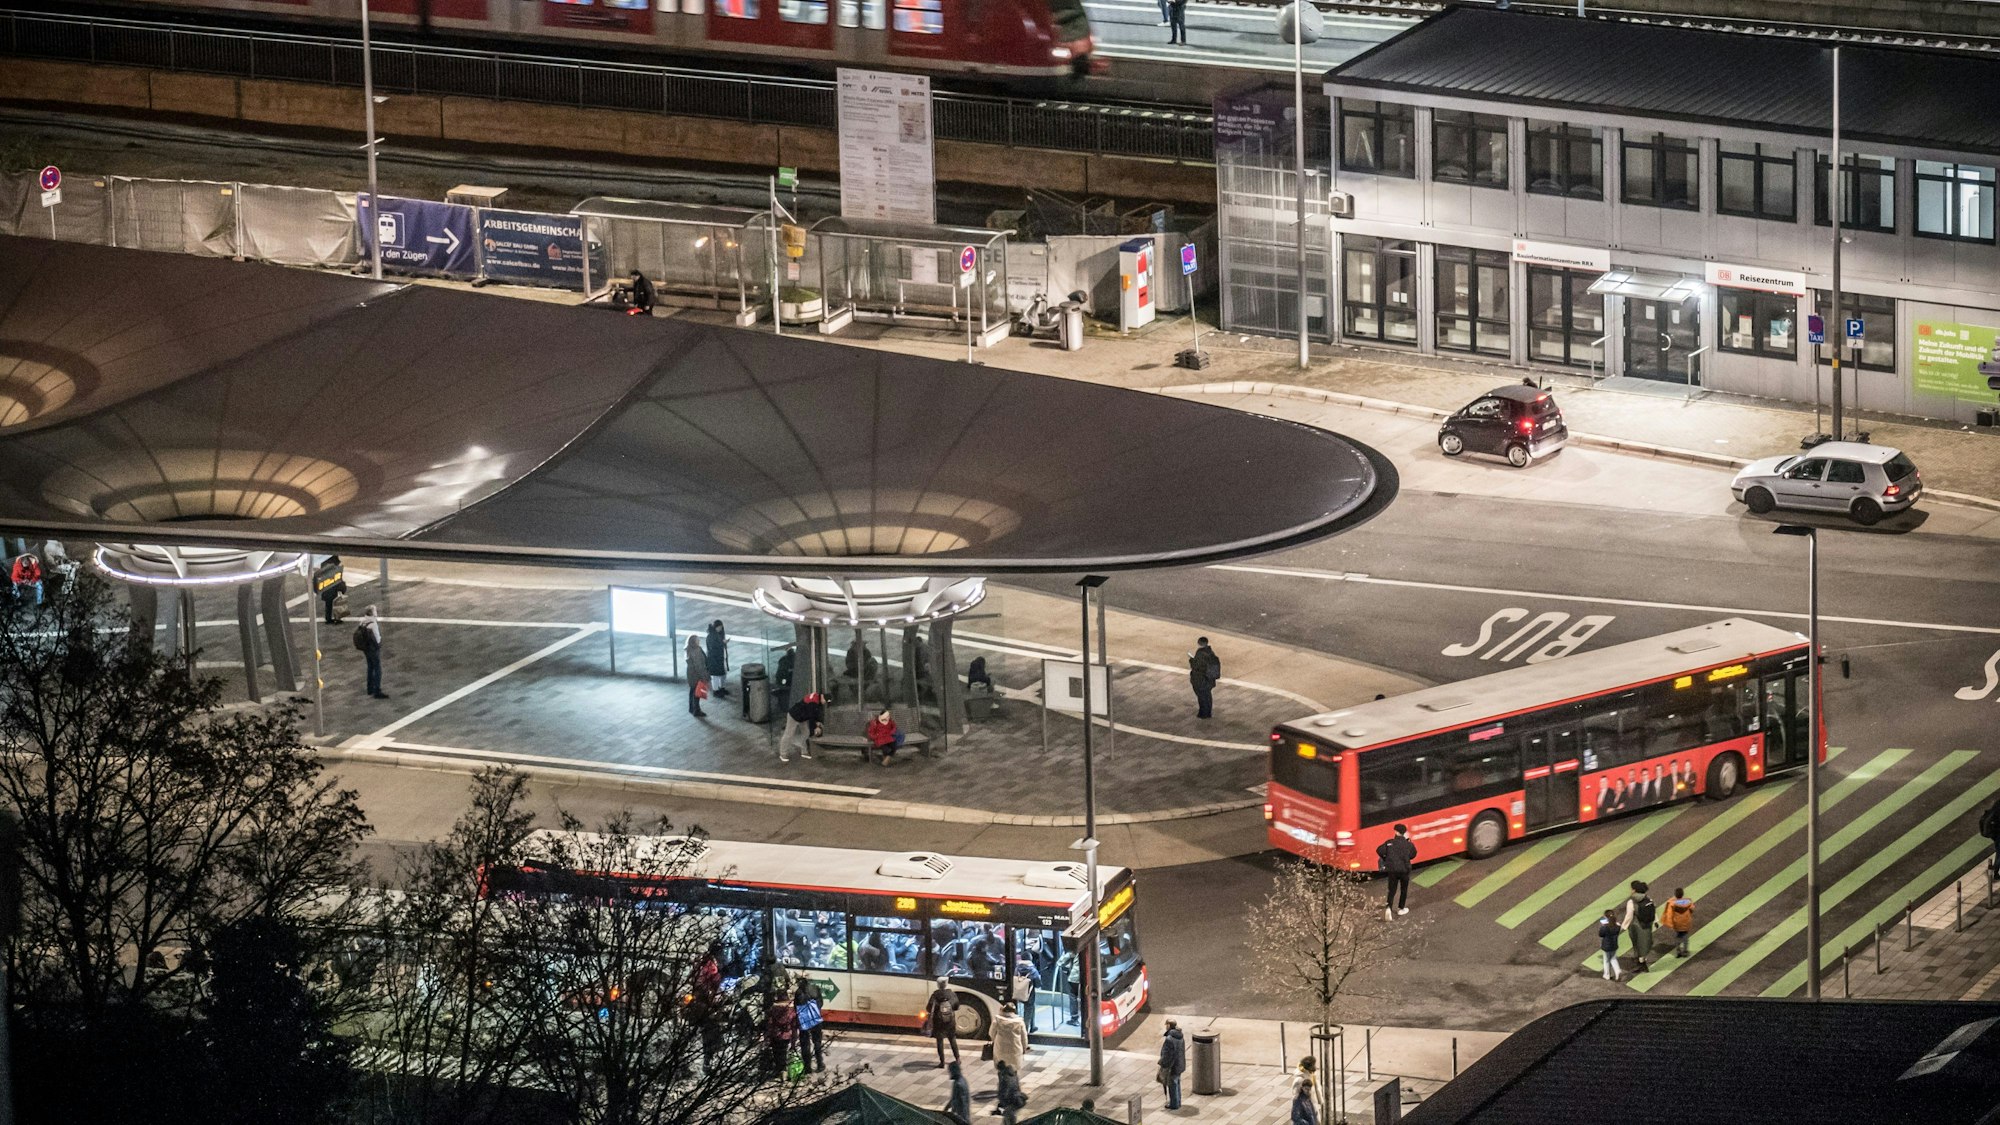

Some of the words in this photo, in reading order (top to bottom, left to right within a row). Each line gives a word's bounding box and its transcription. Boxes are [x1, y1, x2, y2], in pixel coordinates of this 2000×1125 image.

[484, 220, 581, 238] ARBEITSGEMEINSCHA
[386, 249, 400, 259] den
[402, 250, 428, 261] Zügen
[1517, 253, 1581, 265] Bauinformationszentrum
[1184, 263, 1198, 272] TAXI
[1718, 269, 1731, 281] DB
[1740, 273, 1794, 287] Reisezentrum
[1850, 321, 1861, 336] P
[1810, 334, 1825, 343] TAXI
[1918, 339, 1938, 347] Meine
[1939, 341, 1964, 350] Zukunft
[1965, 344, 1977, 352] und
[1918, 347, 1944, 355] Zukunft
[1955, 351, 1985, 361] Mobilität
[1441, 607, 1616, 664] BUS
